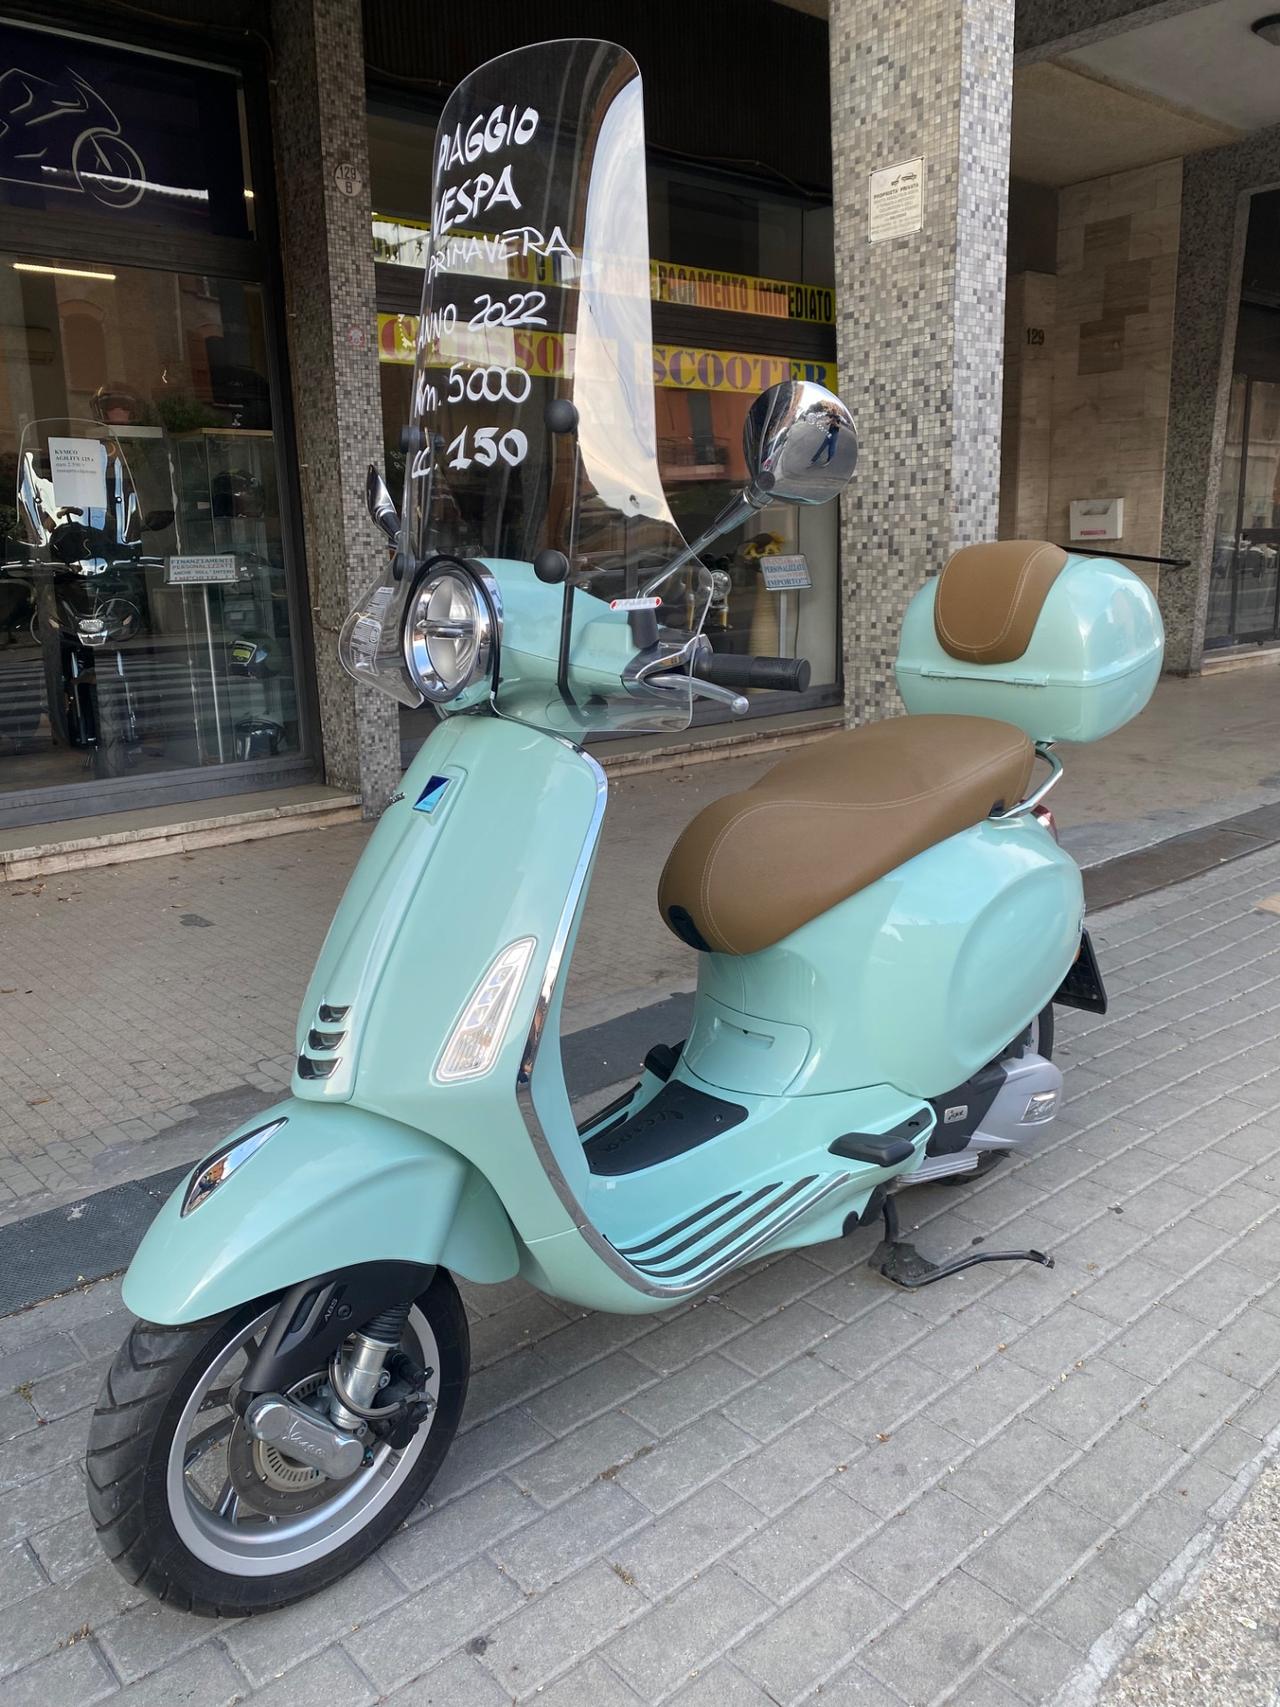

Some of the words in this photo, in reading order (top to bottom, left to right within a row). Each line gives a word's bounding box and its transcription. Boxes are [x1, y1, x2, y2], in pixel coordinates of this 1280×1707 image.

[436, 104, 539, 172] PIAGGIO
[340, 165, 356, 179] 129
[433, 164, 522, 241] VESPA
[428, 226, 576, 284] PRIMAVERA
[467, 291, 547, 332] 2022
[658, 264, 748, 310] PAGAMENTO
[754, 281, 832, 322] IMMEDIATO
[1026, 328, 1045, 345] 129
[447, 362, 531, 404] 5000
[446, 425, 528, 470] 150
